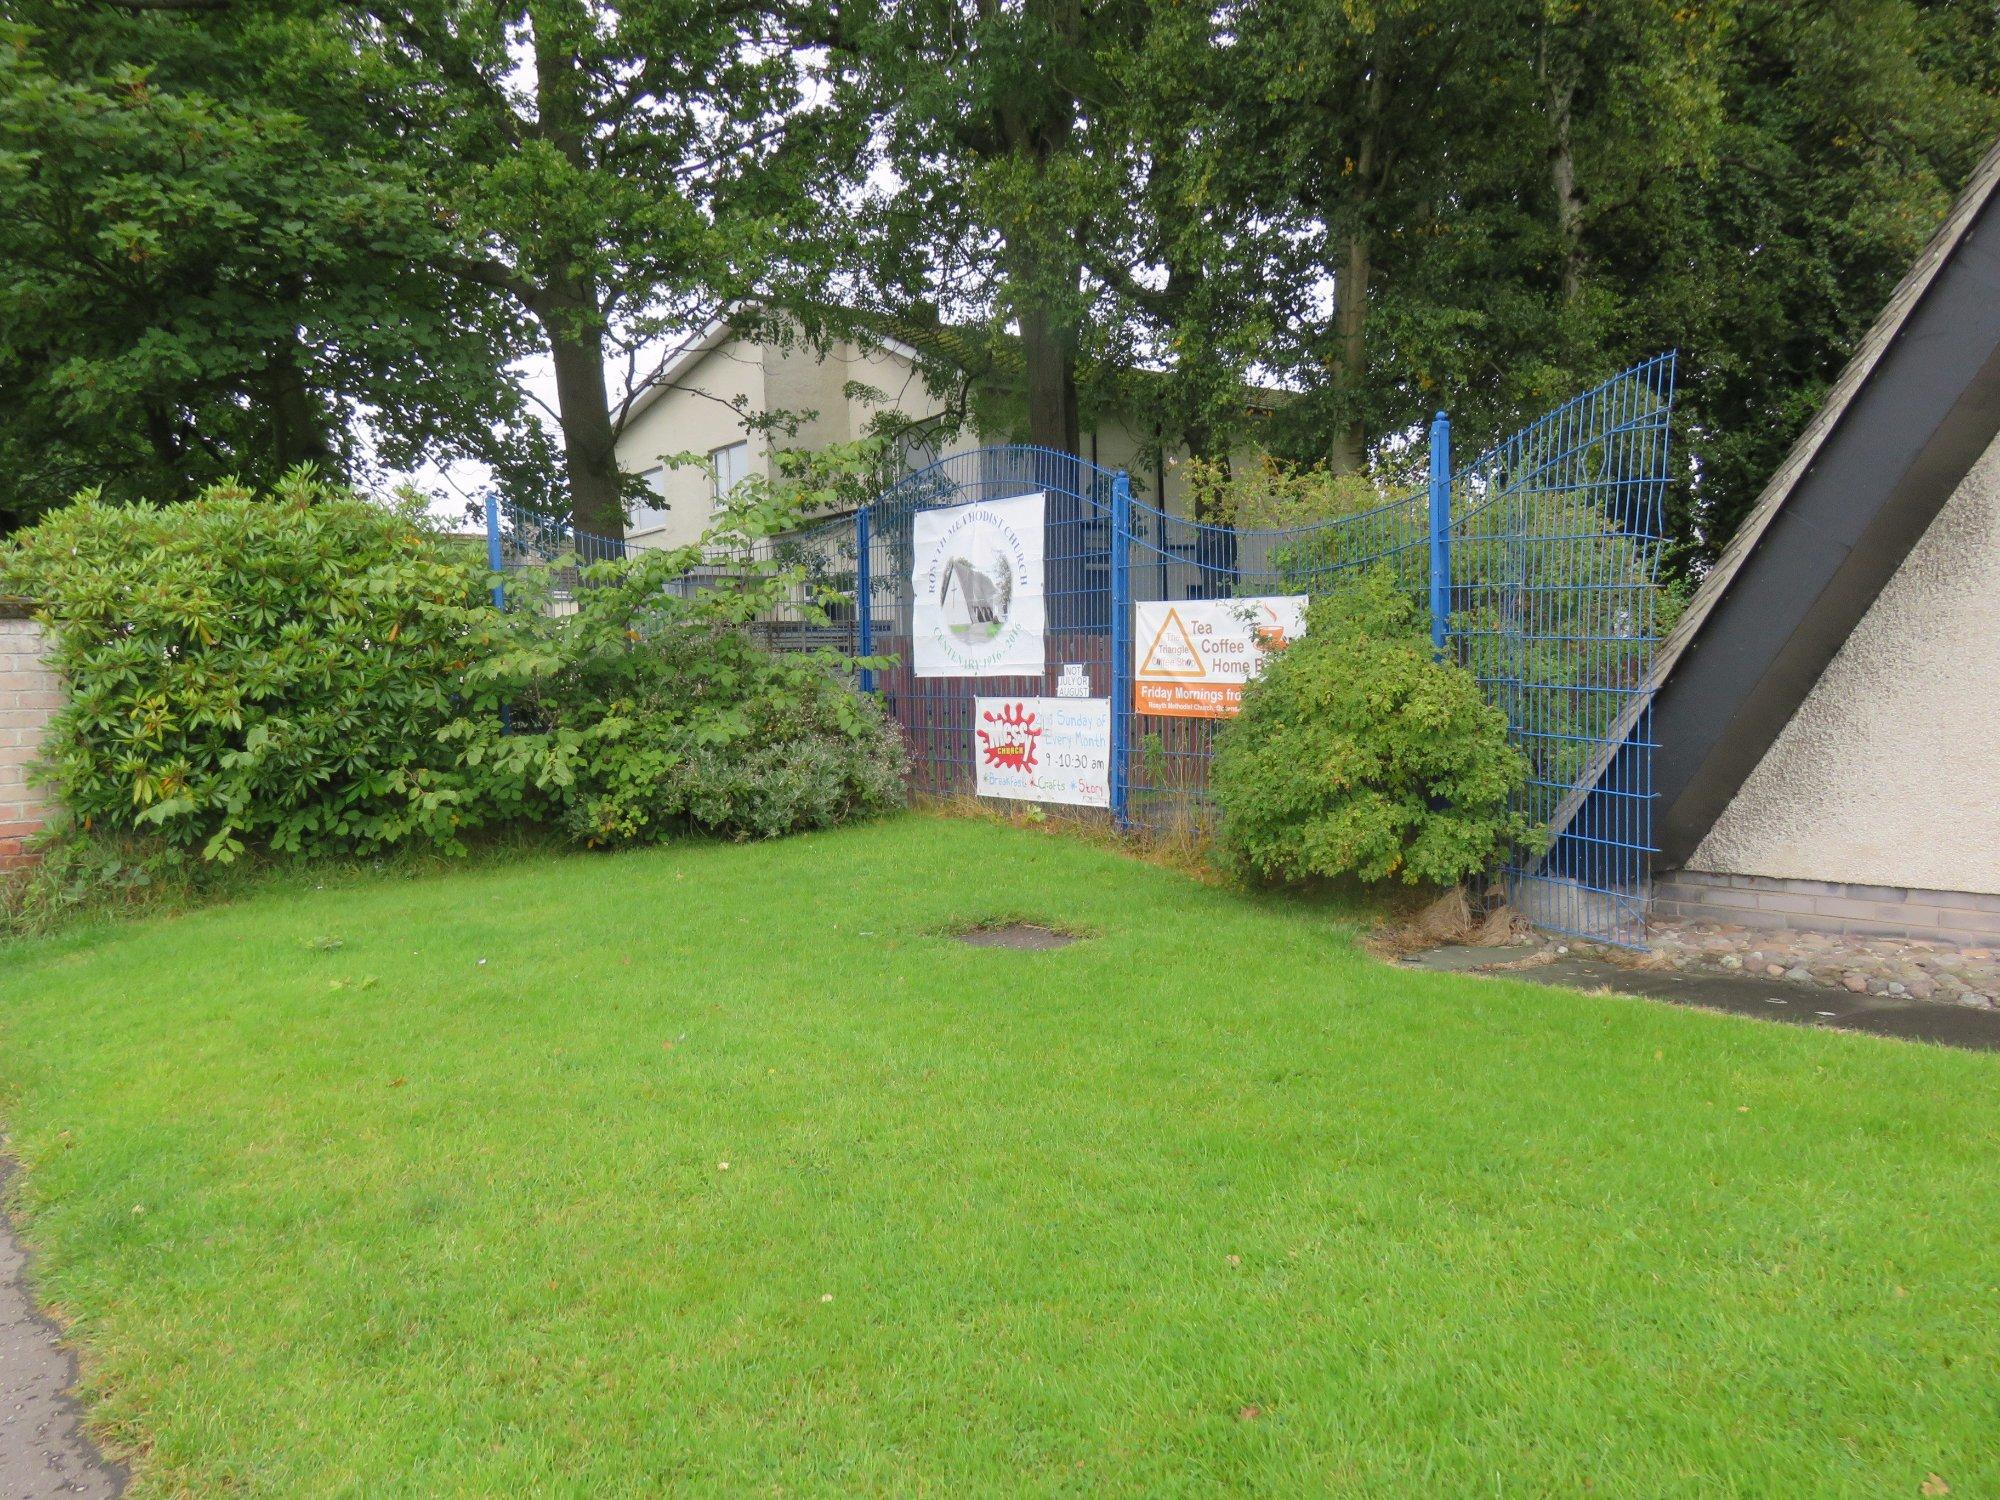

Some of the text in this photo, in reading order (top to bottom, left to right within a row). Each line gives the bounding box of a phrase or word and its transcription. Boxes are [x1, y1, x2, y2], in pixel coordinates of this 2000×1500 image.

[929, 510, 1028, 593] ROSYTH METHODIST CHURCH
[1191, 620, 1212, 635] Tea
[933, 626, 979, 670] CENTENARY
[984, 653, 1002, 667] 1916
[1006, 622, 1022, 648] 2016
[1159, 645, 1188, 656] Triangle
[1201, 638, 1245, 654] Coffee
[1065, 666, 1081, 676] NOT
[1212, 658, 1250, 673] Home
[1059, 676, 1088, 687] JULY OR
[1059, 687, 1089, 697] AUGUST
[1141, 685, 1242, 703] Friday Mornings fro
[1148, 701, 1167, 710] Rosyth
[1167, 702, 1193, 710] Methodist
[1057, 710, 1093, 729] Sunday
[1096, 713, 1107, 727] of
[1045, 729, 1106, 749] Every Month
[997, 747, 1024, 755] CHURCH
[1091, 759, 1104, 770] am
[1078, 778, 1103, 796] Story
